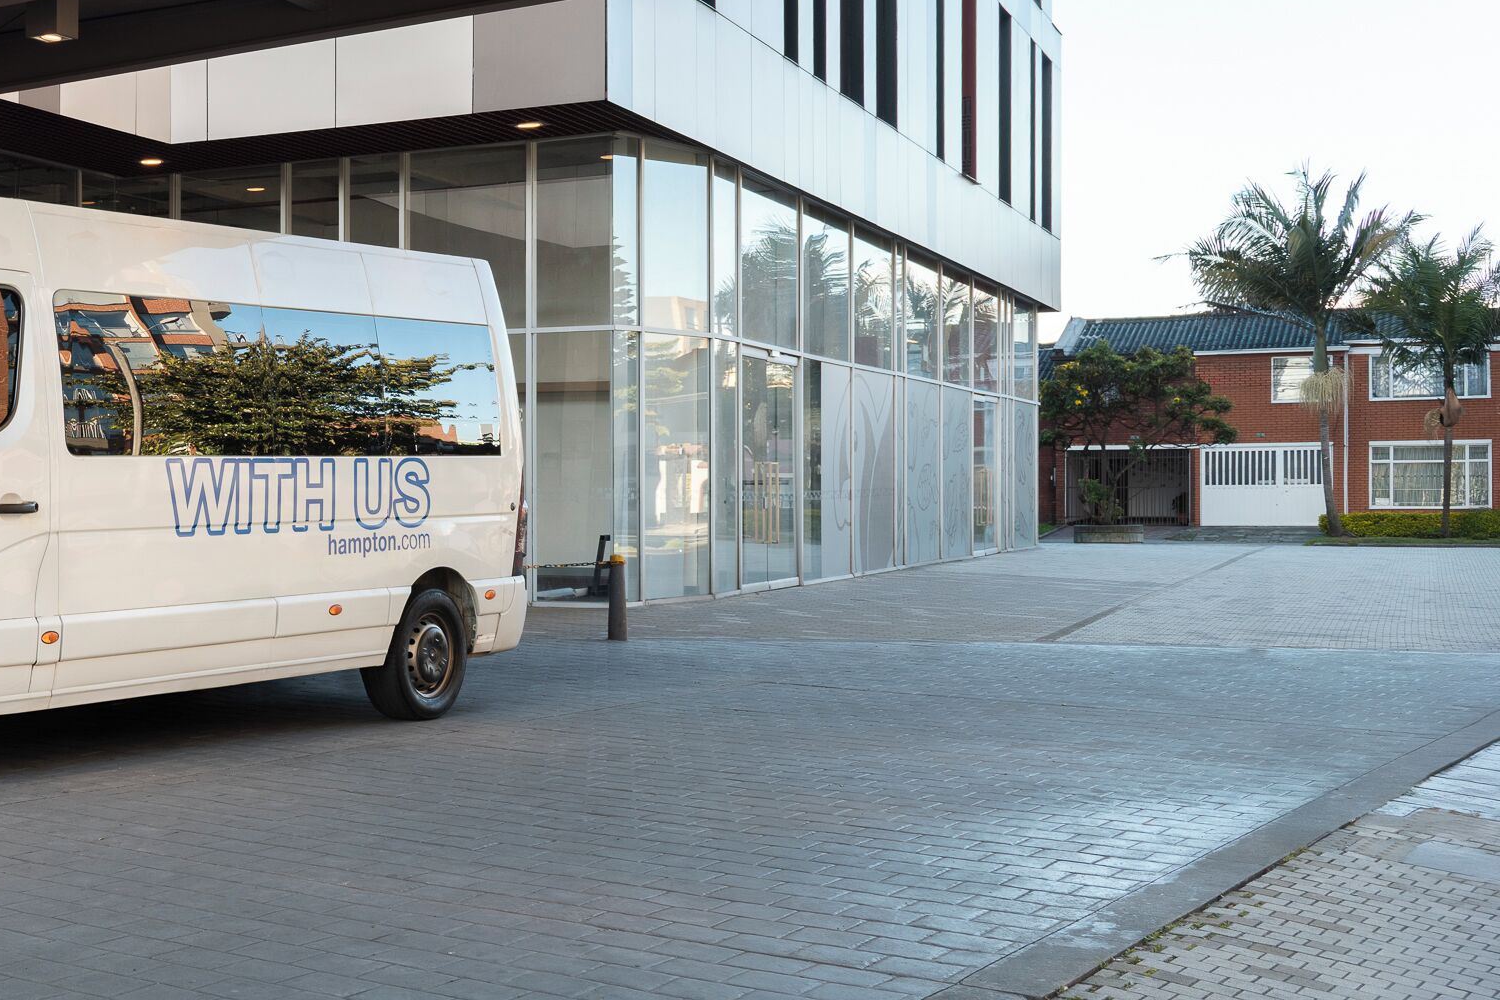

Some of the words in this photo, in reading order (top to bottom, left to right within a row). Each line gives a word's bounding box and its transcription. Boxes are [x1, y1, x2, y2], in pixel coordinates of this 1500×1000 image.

[165, 457, 336, 537] WITH
[353, 457, 431, 530] US
[328, 531, 431, 558] hampton.com
